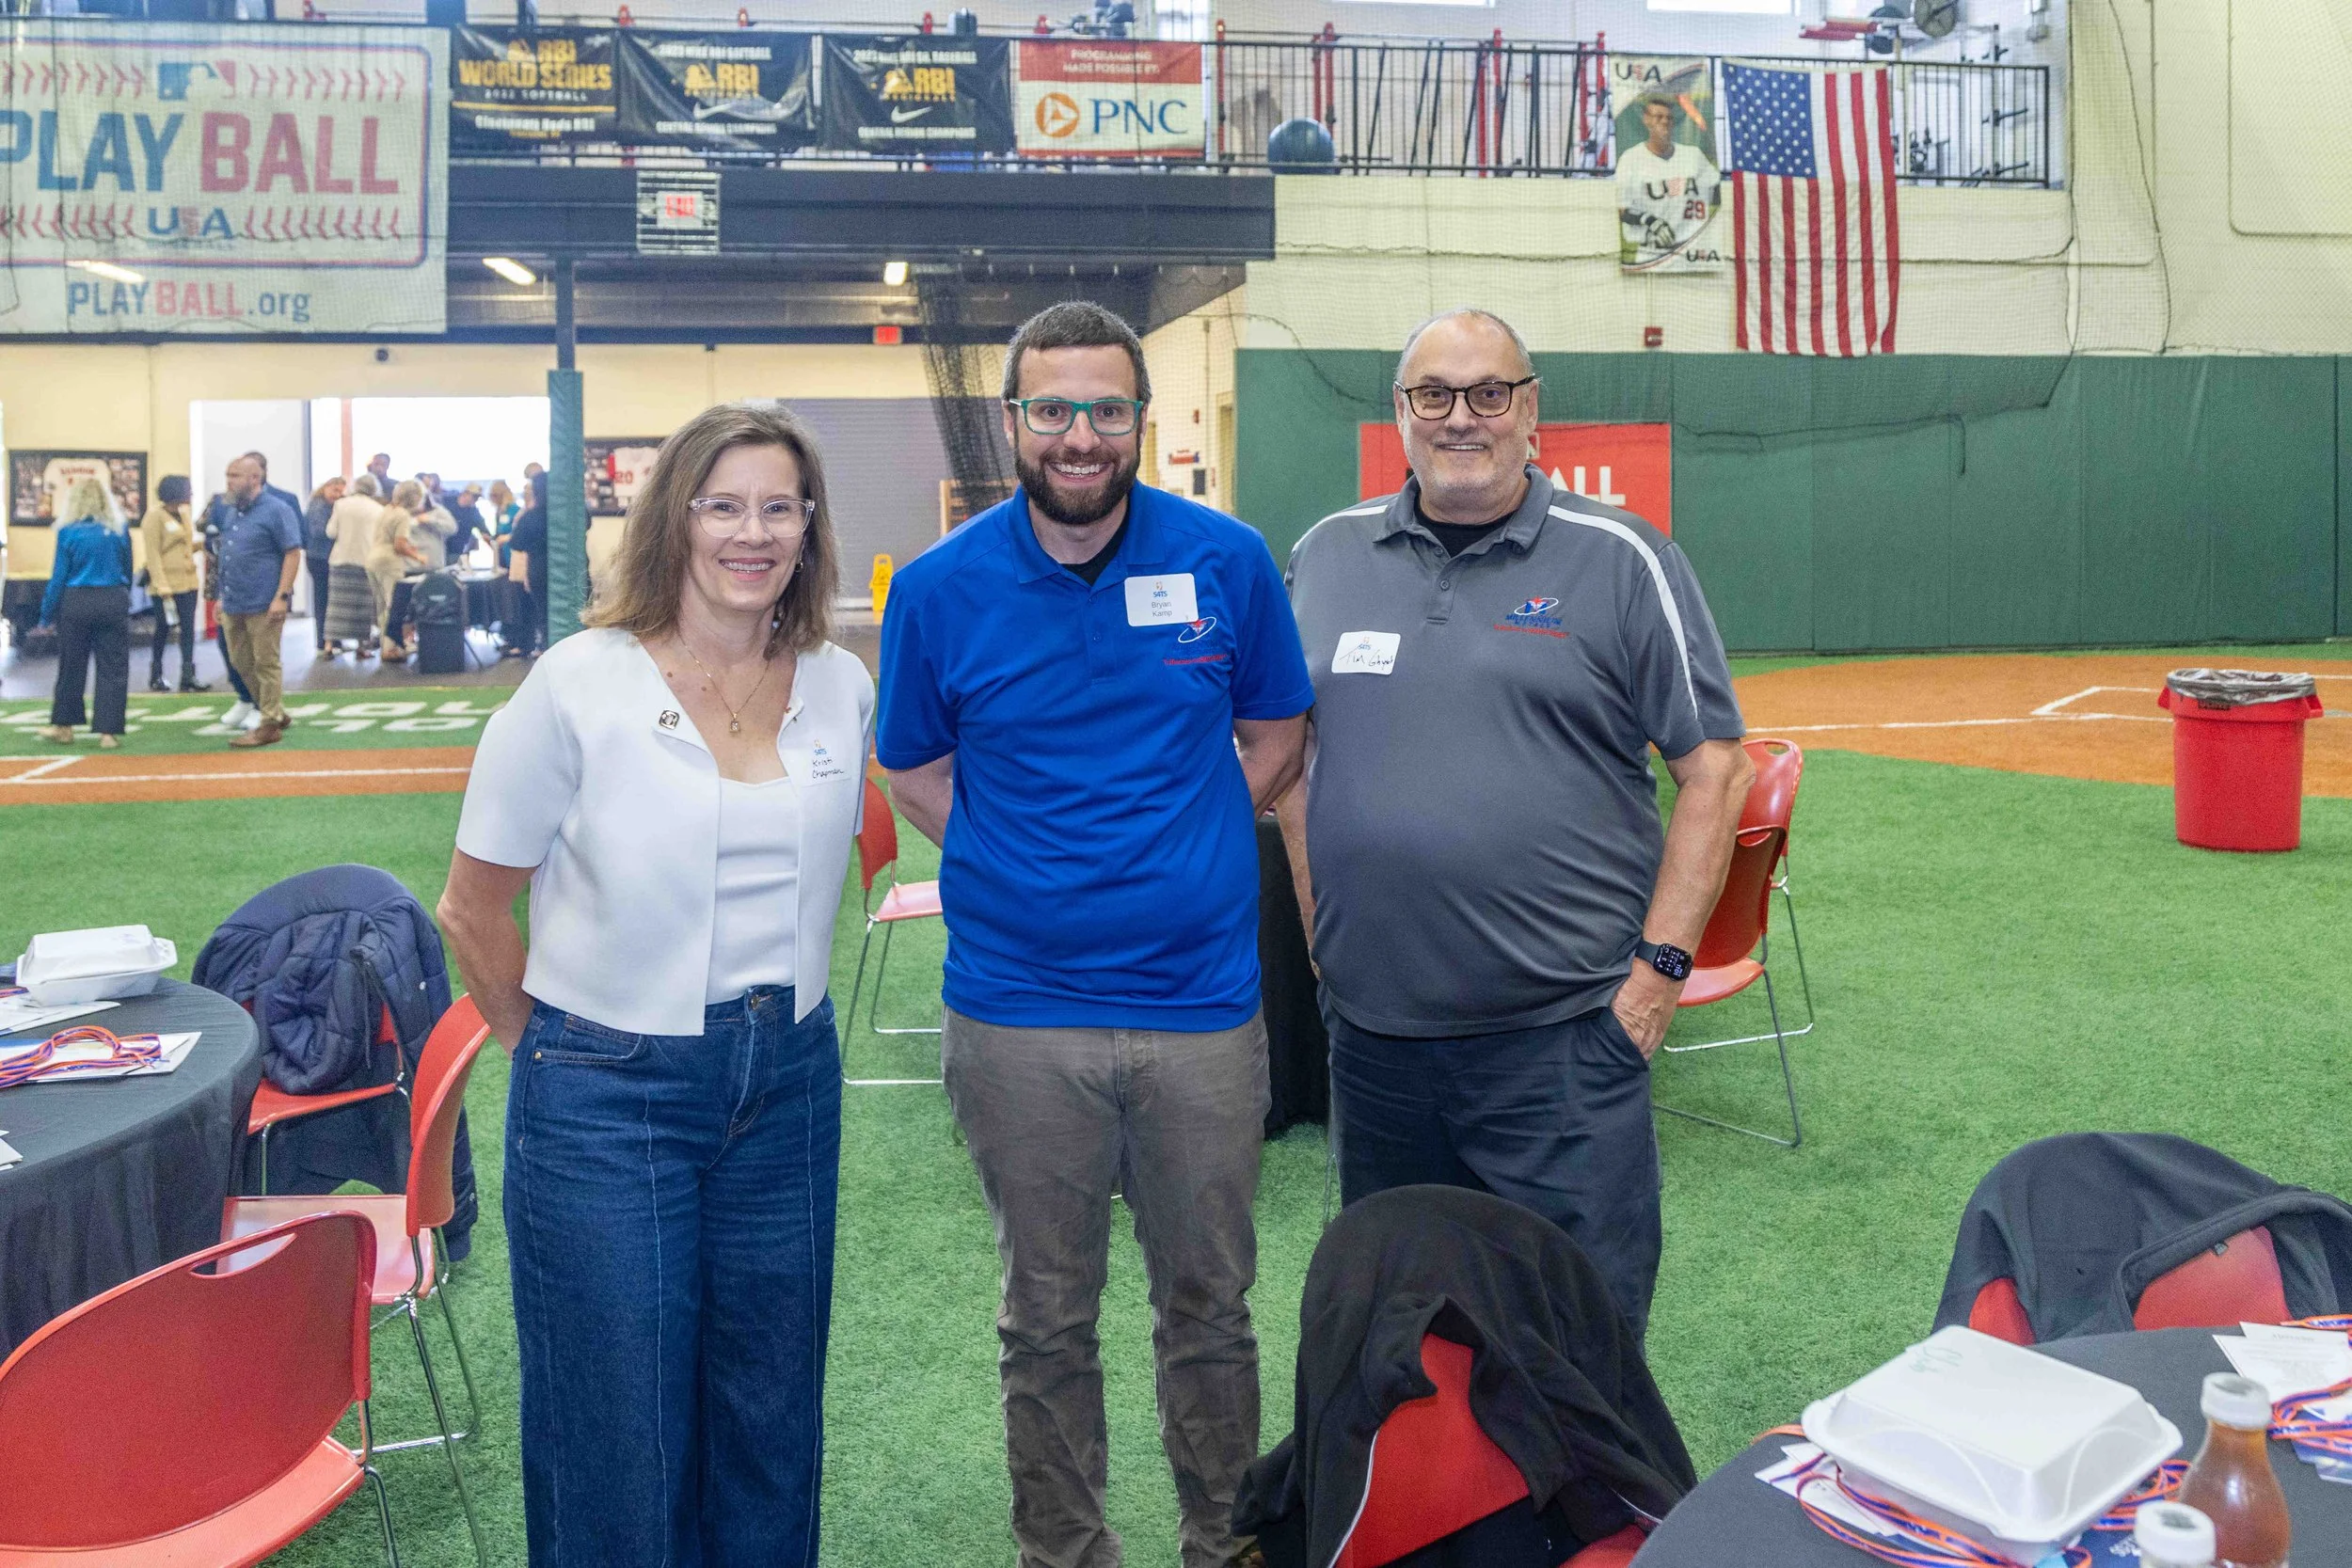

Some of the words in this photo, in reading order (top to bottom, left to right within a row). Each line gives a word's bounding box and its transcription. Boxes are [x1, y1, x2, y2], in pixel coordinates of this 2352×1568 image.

[1071, 49, 1153, 61] PROGRAMMING
[459, 59, 537, 87] WORLD
[540, 63, 612, 90] SERIES
[717, 63, 759, 90] RBI
[914, 67, 956, 95] RBI
[1063, 63, 1093, 73] MADE
[1095, 64, 1142, 75] POSSIBLE
[1615, 62, 1662, 83] USA
[1089, 98, 1189, 135] PNC
[200, 111, 399, 195] BALL
[1646, 177, 1700, 200] USA
[148, 207, 234, 239] USA
[1683, 199, 1708, 220] 29
[68, 281, 312, 323] PLAYBALL.org
[1550, 466, 1626, 506] ALL
[1151, 601, 1172, 610] Bryan
[1152, 610, 1173, 618] Kamp
